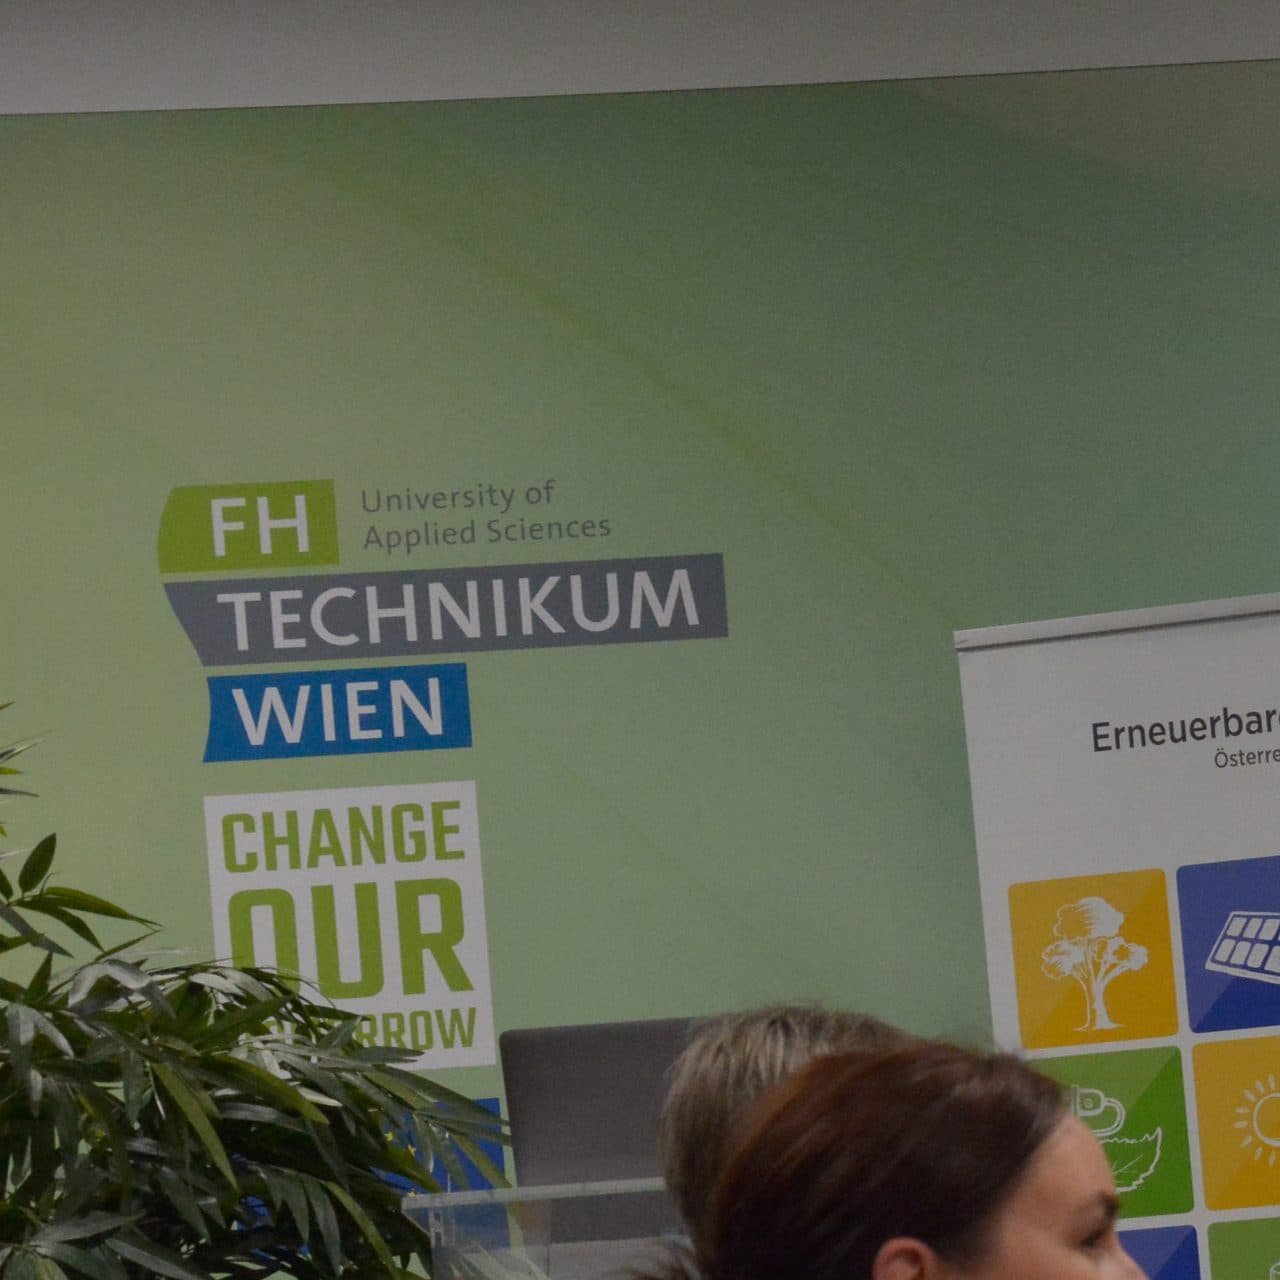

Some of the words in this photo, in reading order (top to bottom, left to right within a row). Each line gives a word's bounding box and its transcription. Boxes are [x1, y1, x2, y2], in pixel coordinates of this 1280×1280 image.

[210, 493, 310, 557] FH
[361, 482, 515, 514] University
[524, 478, 557, 506] of
[363, 518, 477, 556] Applied
[487, 513, 612, 544] Sciences
[216, 567, 700, 652] TECHNIKUM
[232, 676, 444, 746] WIEN
[220, 799, 466, 874] CHANGE
[227, 876, 475, 1000] OUR
